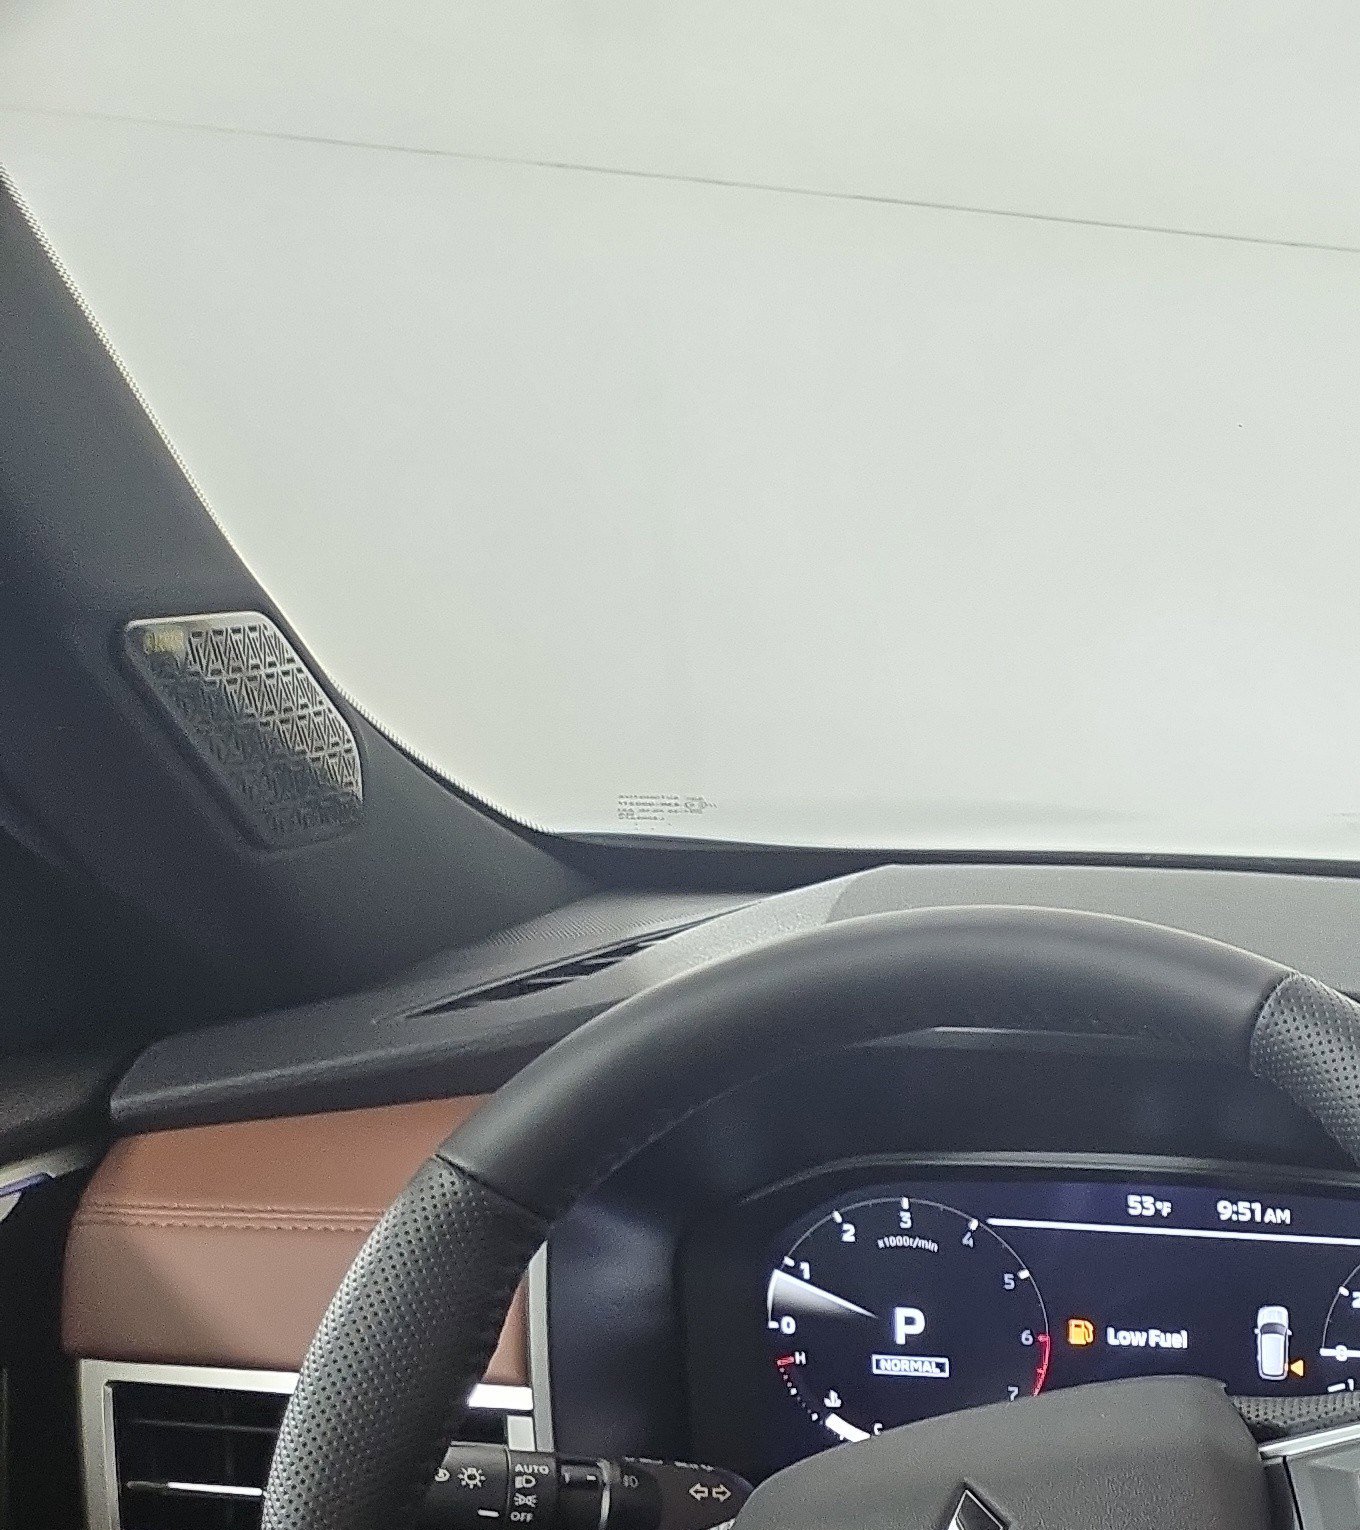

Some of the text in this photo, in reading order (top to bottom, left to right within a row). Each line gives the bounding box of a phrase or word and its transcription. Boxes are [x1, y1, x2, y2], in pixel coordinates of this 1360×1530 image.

[899, 1211, 912, 1228] 3
[842, 1224, 856, 1242] 2
[962, 1233, 974, 1247] 4
[800, 1262, 810, 1279] 1
[1003, 1274, 1015, 1290] 5
[780, 1316, 796, 1334] 0
[895, 1307, 925, 1344] P
[1021, 1330, 1033, 1345] 6
[1107, 1326, 1188, 1349] Low Fuel
[795, 1351, 806, 1365] H
[880, 1359, 940, 1373] NORMAL
[1007, 1386, 1019, 1400] 7
[515, 1464, 549, 1475] AUTO
[511, 1512, 533, 1523] OFF
